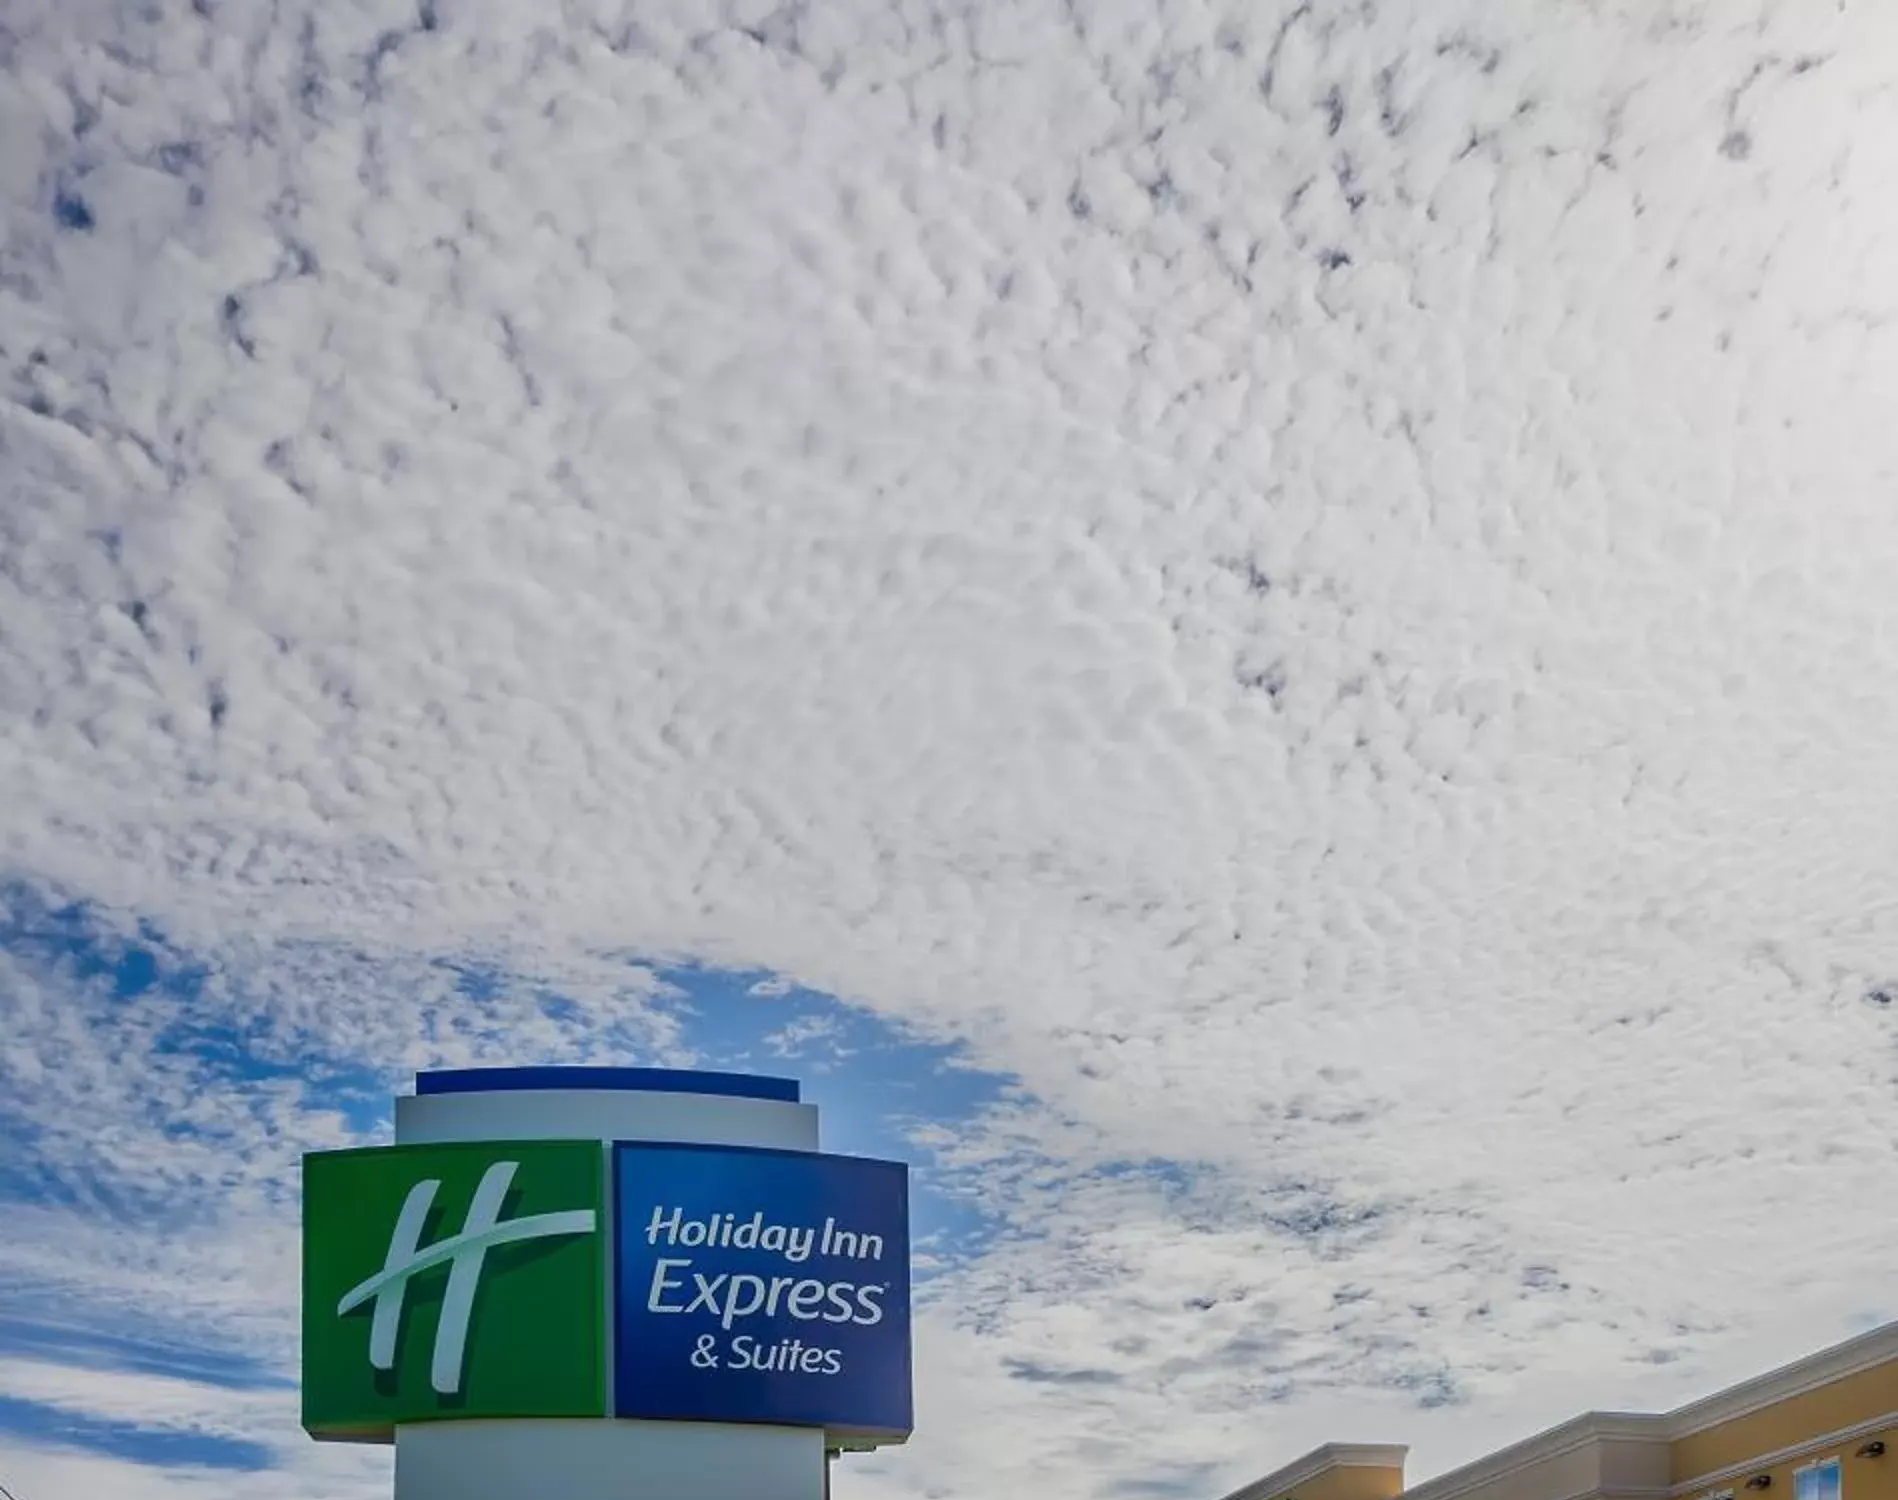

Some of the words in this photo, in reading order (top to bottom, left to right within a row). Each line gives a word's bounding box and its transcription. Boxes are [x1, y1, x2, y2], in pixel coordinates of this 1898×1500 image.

[645, 1205, 815, 1262] Holiday
[820, 1217, 884, 1261] Inn
[647, 1257, 886, 1330] Express
[690, 1333, 719, 1369] &
[727, 1335, 843, 1375] Suites
